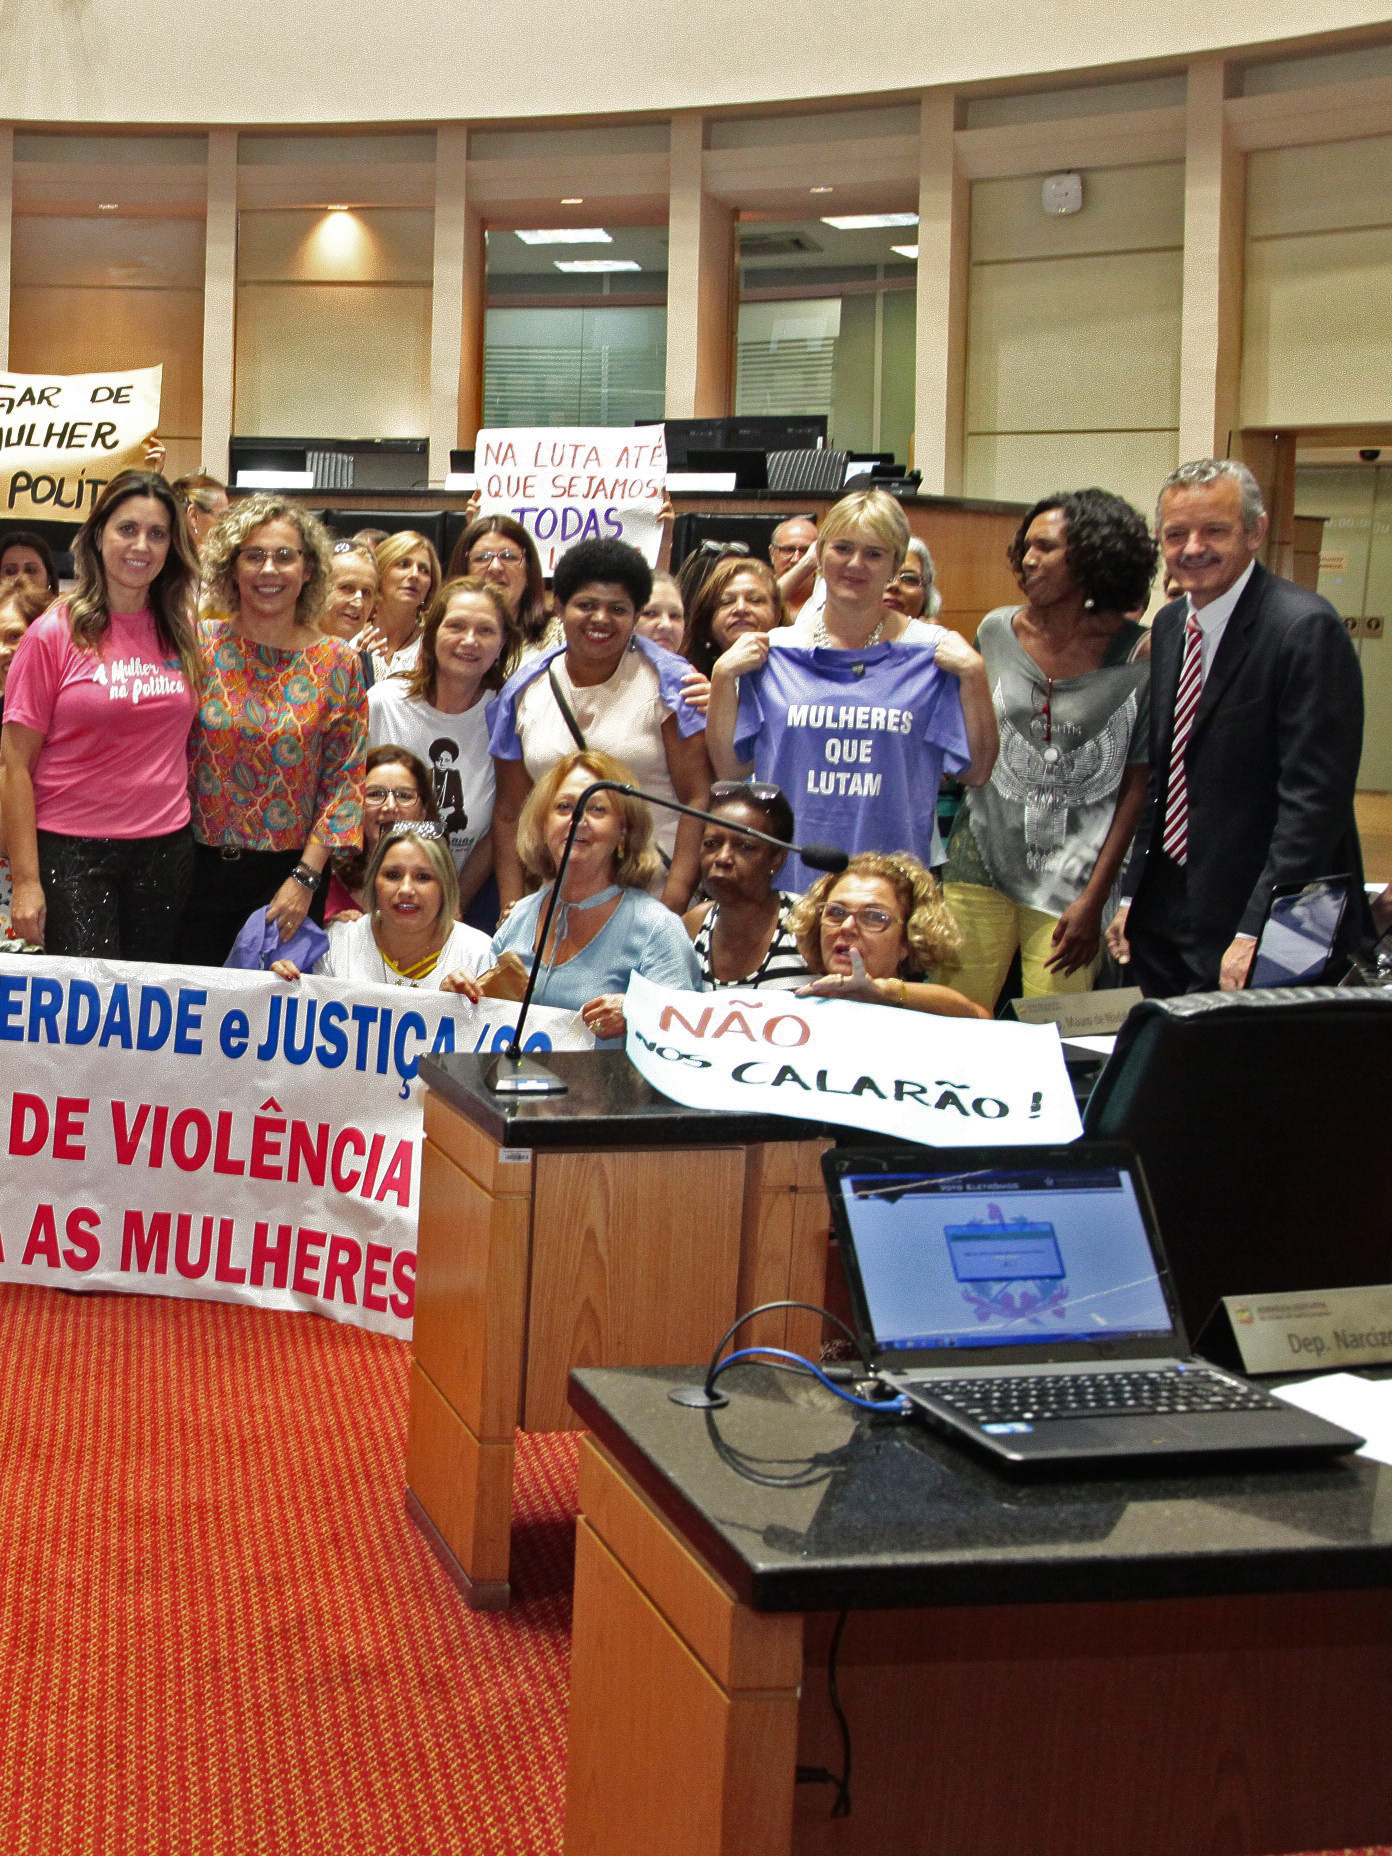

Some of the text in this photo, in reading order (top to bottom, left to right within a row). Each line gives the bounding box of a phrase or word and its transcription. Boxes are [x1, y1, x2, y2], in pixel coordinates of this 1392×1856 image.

[90, 385, 134, 404] DE
[484, 434, 664, 469] NA LUTA ATÉ
[8, 468, 109, 510] POLÍT
[487, 474, 658, 500] QUE SEJAMOS
[511, 507, 624, 542] TODAS
[787, 704, 914, 734] MULHERES
[825, 738, 873, 765] QUE
[807, 770, 883, 797] LUTAM
[219, 1009, 249, 1059] e
[659, 1000, 811, 1047] NÃO
[635, 1031, 712, 1068] NOS
[731, 1061, 1009, 1119] CALARÃO
[8, 1091, 90, 1160] DE
[111, 1096, 414, 1207] VIOLÊNCIA
[21, 1204, 102, 1272] AS
[120, 1210, 417, 1319] MULHERES
